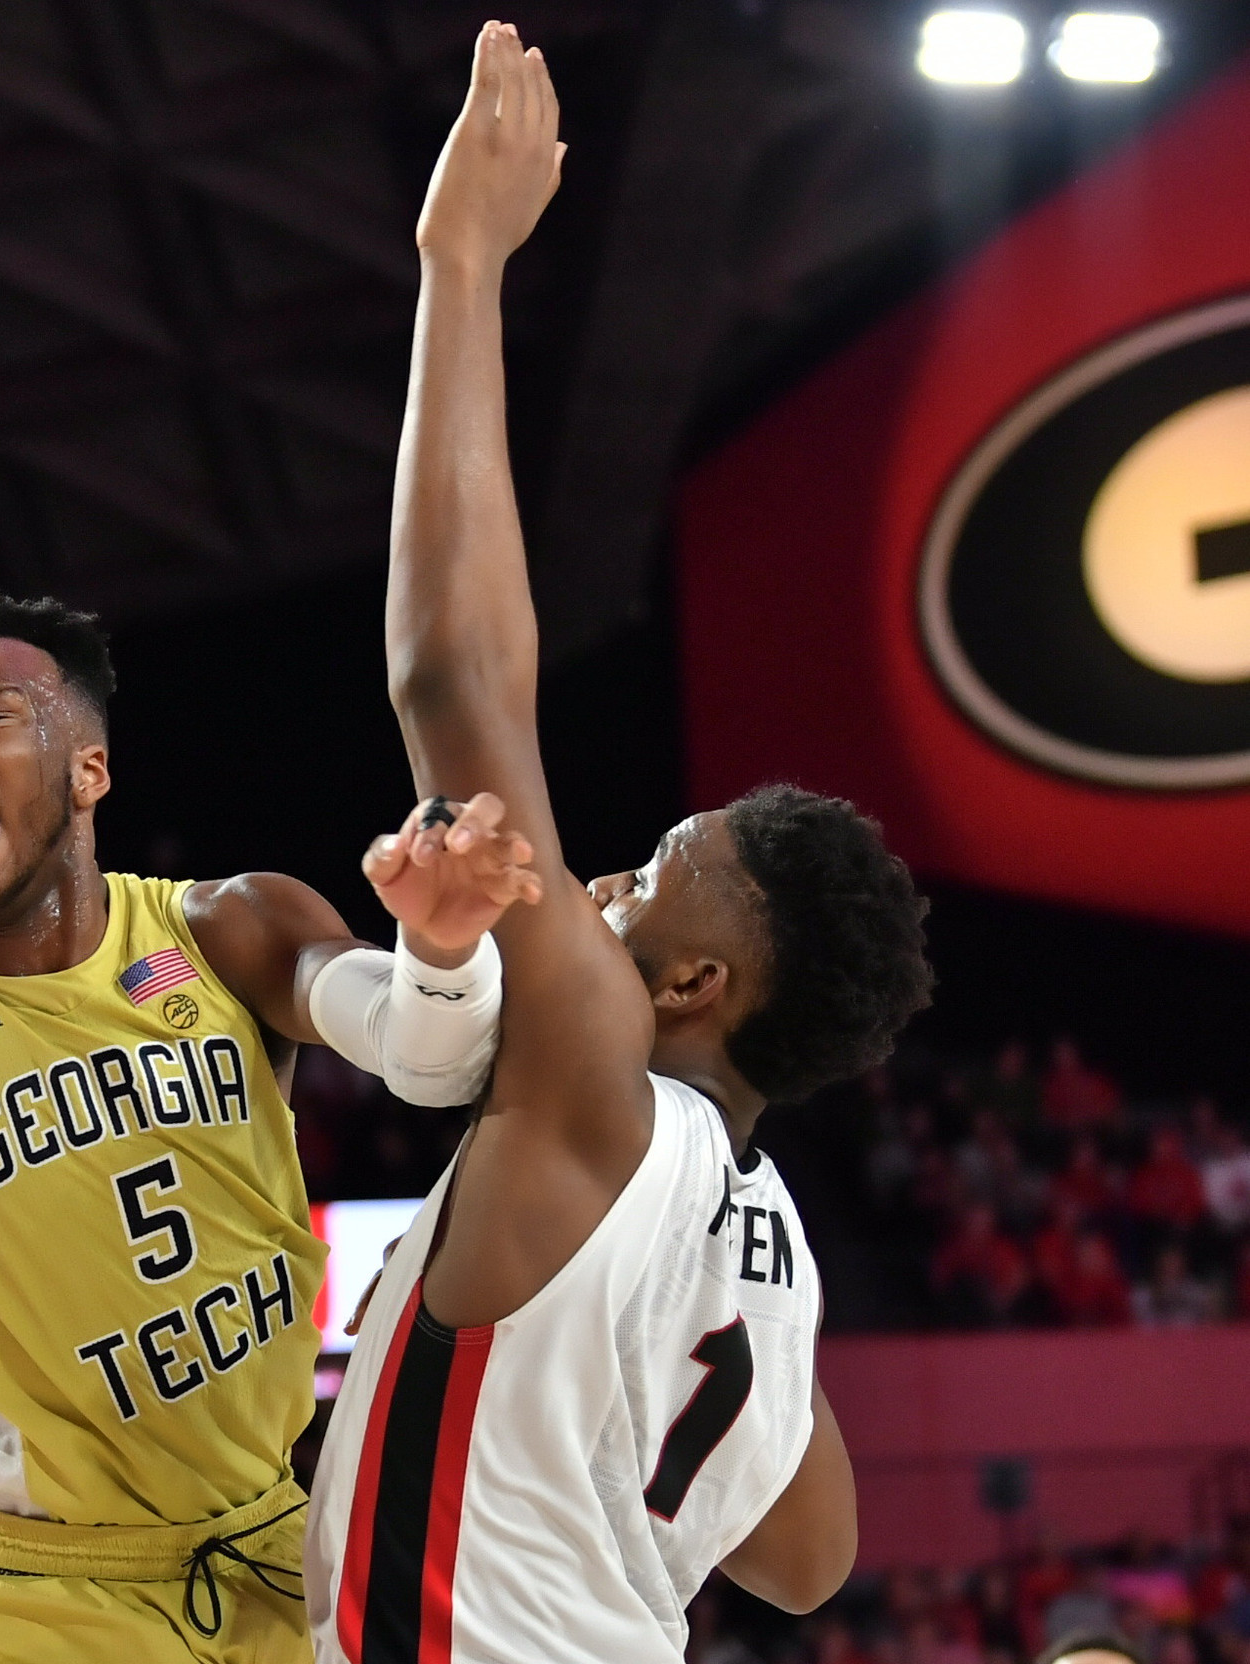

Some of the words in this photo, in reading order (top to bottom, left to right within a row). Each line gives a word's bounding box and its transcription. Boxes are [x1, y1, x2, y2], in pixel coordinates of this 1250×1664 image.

[170, 998, 194, 1021] ACC
[110, 1151, 198, 1284] 5
[77, 1254, 297, 1423] TECH
[644, 1311, 754, 1522] 1
